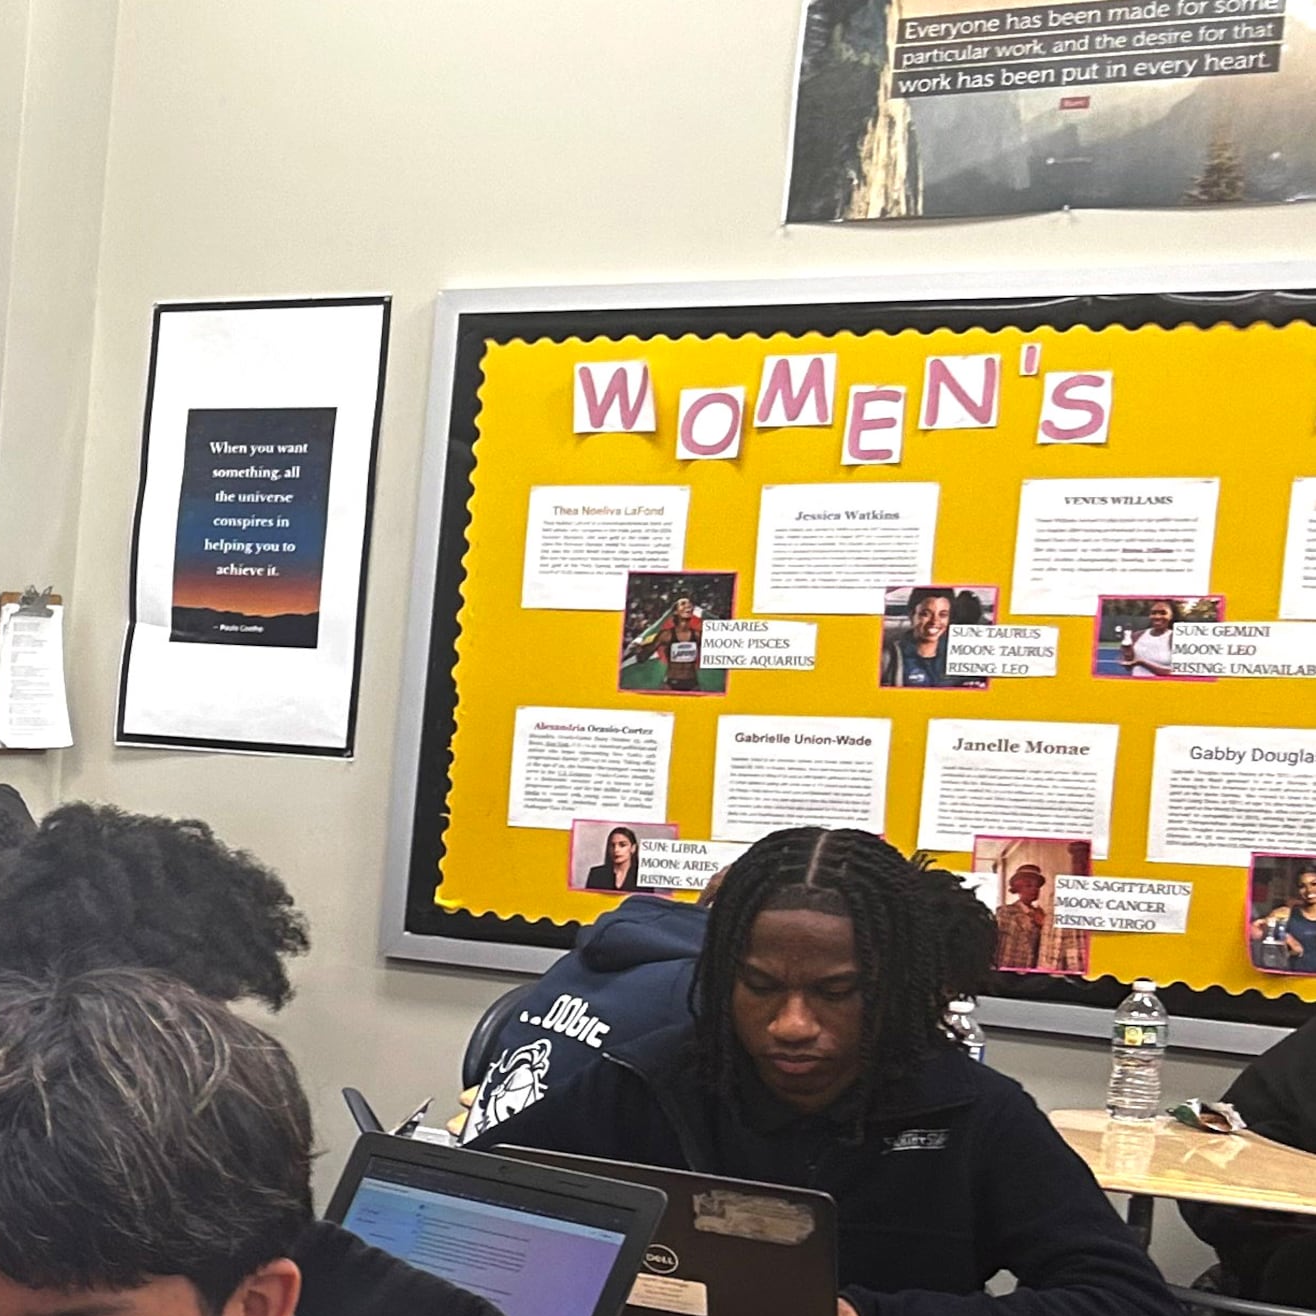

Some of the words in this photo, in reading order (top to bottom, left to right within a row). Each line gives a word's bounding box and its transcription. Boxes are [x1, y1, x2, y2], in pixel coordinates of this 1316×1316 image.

[905, 18, 1000, 41] Everyone
[1006, 13, 1042, 30] has
[1048, 9, 1101, 27] been
[1107, 4, 1169, 22] made
[1175, 0, 1209, 17] for
[1214, 0, 1281, 14] some
[902, 44, 990, 67] particular
[1052, 35, 1089, 54] and
[1094, 33, 1126, 51] the
[1132, 27, 1192, 47] desire
[1198, 24, 1229, 42] for
[1233, 21, 1275, 39] that
[898, 73, 953, 94] work
[957, 70, 995, 89] has
[1000, 65, 1055, 85] been
[1061, 62, 1101, 84] put
[1107, 58, 1127, 77] in
[1134, 54, 1198, 77] every
[579, 346, 1105, 460] WOMEN'S
[209, 441, 247, 454] When
[249, 443, 274, 457] you
[277, 442, 308, 454] want
[284, 466, 300, 479] all
[215, 491, 235, 502] the
[238, 492, 294, 503] universe
[1065, 497, 1108, 505] VENUS
[553, 506, 579, 516] Thea
[624, 506, 664, 516] LaFond
[795, 510, 841, 522] Jessica
[845, 510, 899, 521] Watkins
[213, 515, 274, 530] conspires
[276, 515, 290, 528] in
[204, 538, 253, 554] helping
[256, 542, 280, 554] you
[282, 540, 296, 552] to
[216, 564, 264, 576] achieve
[267, 565, 280, 577] it.
[952, 627, 983, 637] SUN:
[986, 628, 1041, 639] TAURUS
[1176, 626, 1208, 637] SUN:
[1212, 626, 1270, 638] GEMINI
[703, 639, 744, 649] MOON:
[747, 639, 790, 649] PISCES
[1174, 644, 1223, 656] MOON:
[1227, 645, 1256, 656] LEO
[950, 645, 994, 656] MOON:
[999, 646, 1054, 658] TAURUS
[703, 655, 746, 666] RISING:
[750, 656, 815, 668] AQUARIUS
[949, 663, 997, 674] RISING:
[1002, 664, 1028, 675] LEO
[1172, 662, 1225, 674] RISING:
[1230, 663, 1316, 677] UNAVAILAB
[534, 722, 585, 732] Alexandria
[735, 732, 790, 745] Gabrielle
[794, 734, 872, 746] Union-Wade
[952, 738, 1020, 753] Janelle
[1025, 740, 1090, 756] Monae
[1190, 746, 1246, 765] Gabby
[642, 841, 668, 852] SUN:
[671, 843, 707, 855] LIBRA
[641, 858, 680, 870] MOON:
[682, 860, 718, 871] ARIES
[640, 875, 682, 887] RISING:
[1057, 879, 1089, 892] SUN:
[1092, 880, 1191, 896] SAGITTARIUS
[1056, 896, 1103, 909] MOON:
[1106, 898, 1166, 913] CANCER
[1055, 914, 1105, 928] RISING:
[1109, 916, 1155, 931] VIRGO
[646, 1253, 674, 1265] DELL
